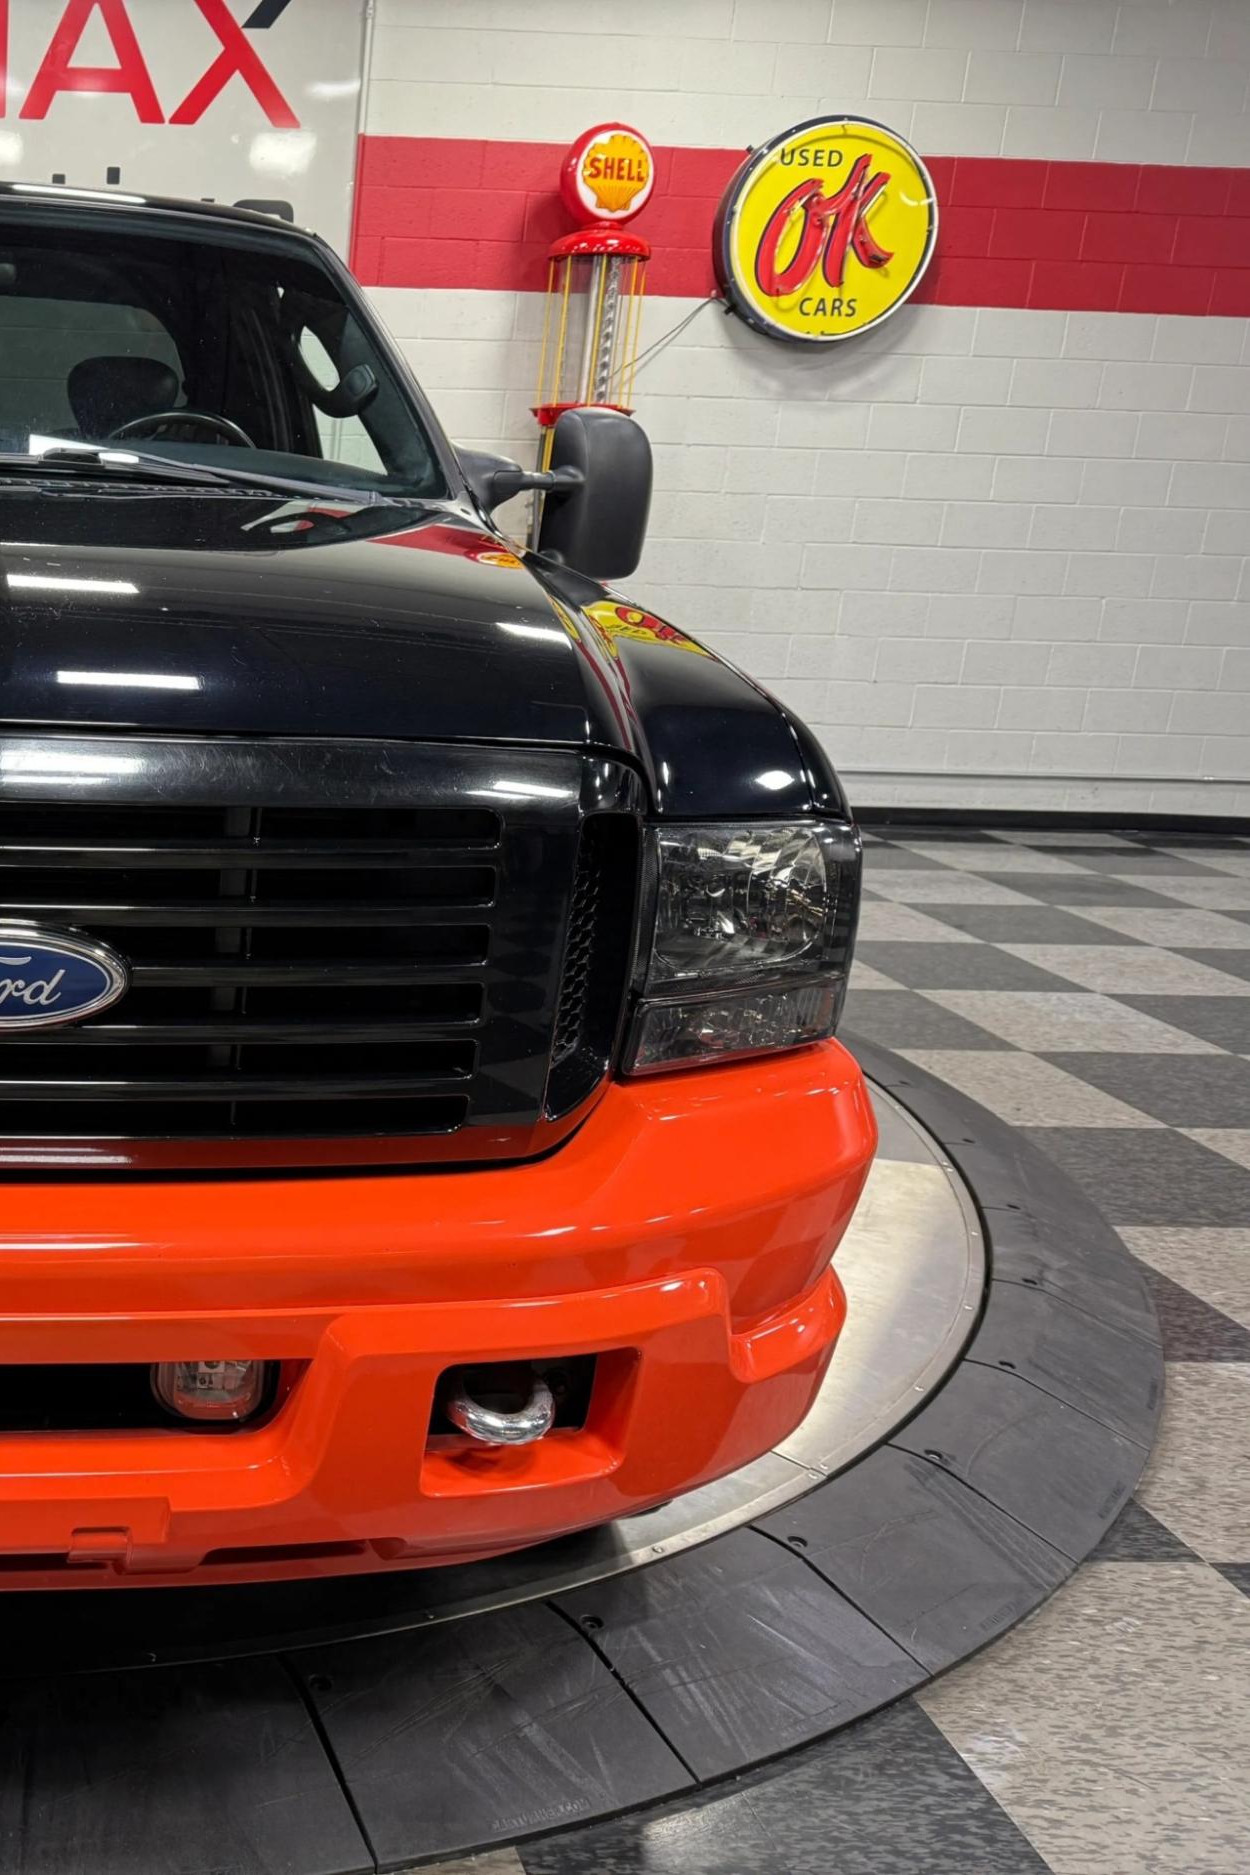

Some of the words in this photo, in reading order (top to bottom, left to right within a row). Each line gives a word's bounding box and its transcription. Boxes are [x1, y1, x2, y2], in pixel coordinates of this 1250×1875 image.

[781, 148, 843, 168] USED
[589, 158, 647, 182] SHELL
[755, 154, 894, 297] OK
[799, 297, 857, 317] CARS
